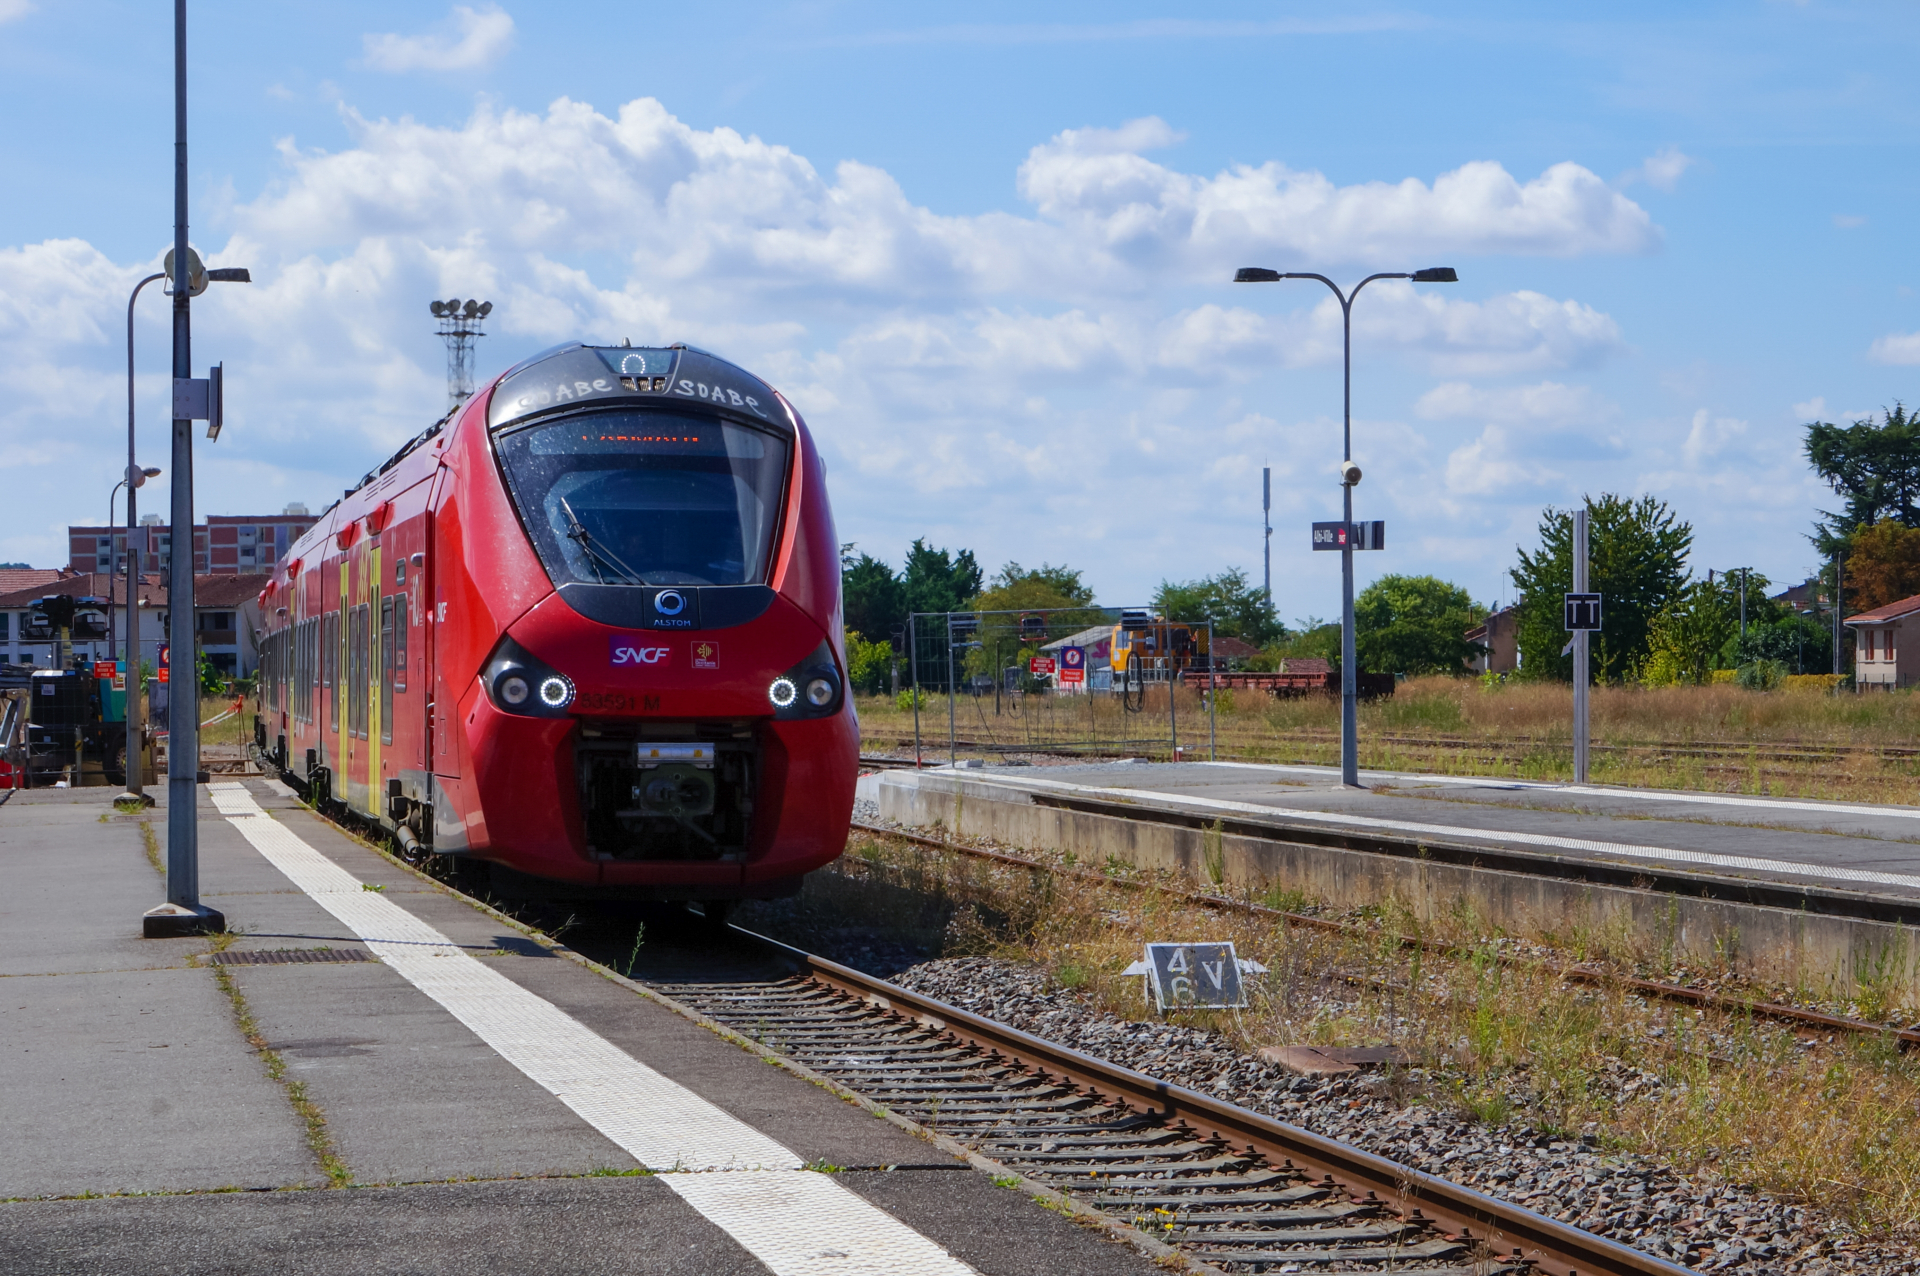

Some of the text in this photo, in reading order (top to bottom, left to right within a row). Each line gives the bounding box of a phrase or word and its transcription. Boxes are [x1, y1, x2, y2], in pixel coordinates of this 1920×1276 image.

[653, 619, 691, 627] ALSTOM
[612, 647, 670, 664] SNCF
[643, 694, 660, 711] M
[1167, 948, 1189, 975] 4
[1202, 960, 1223, 990] V
